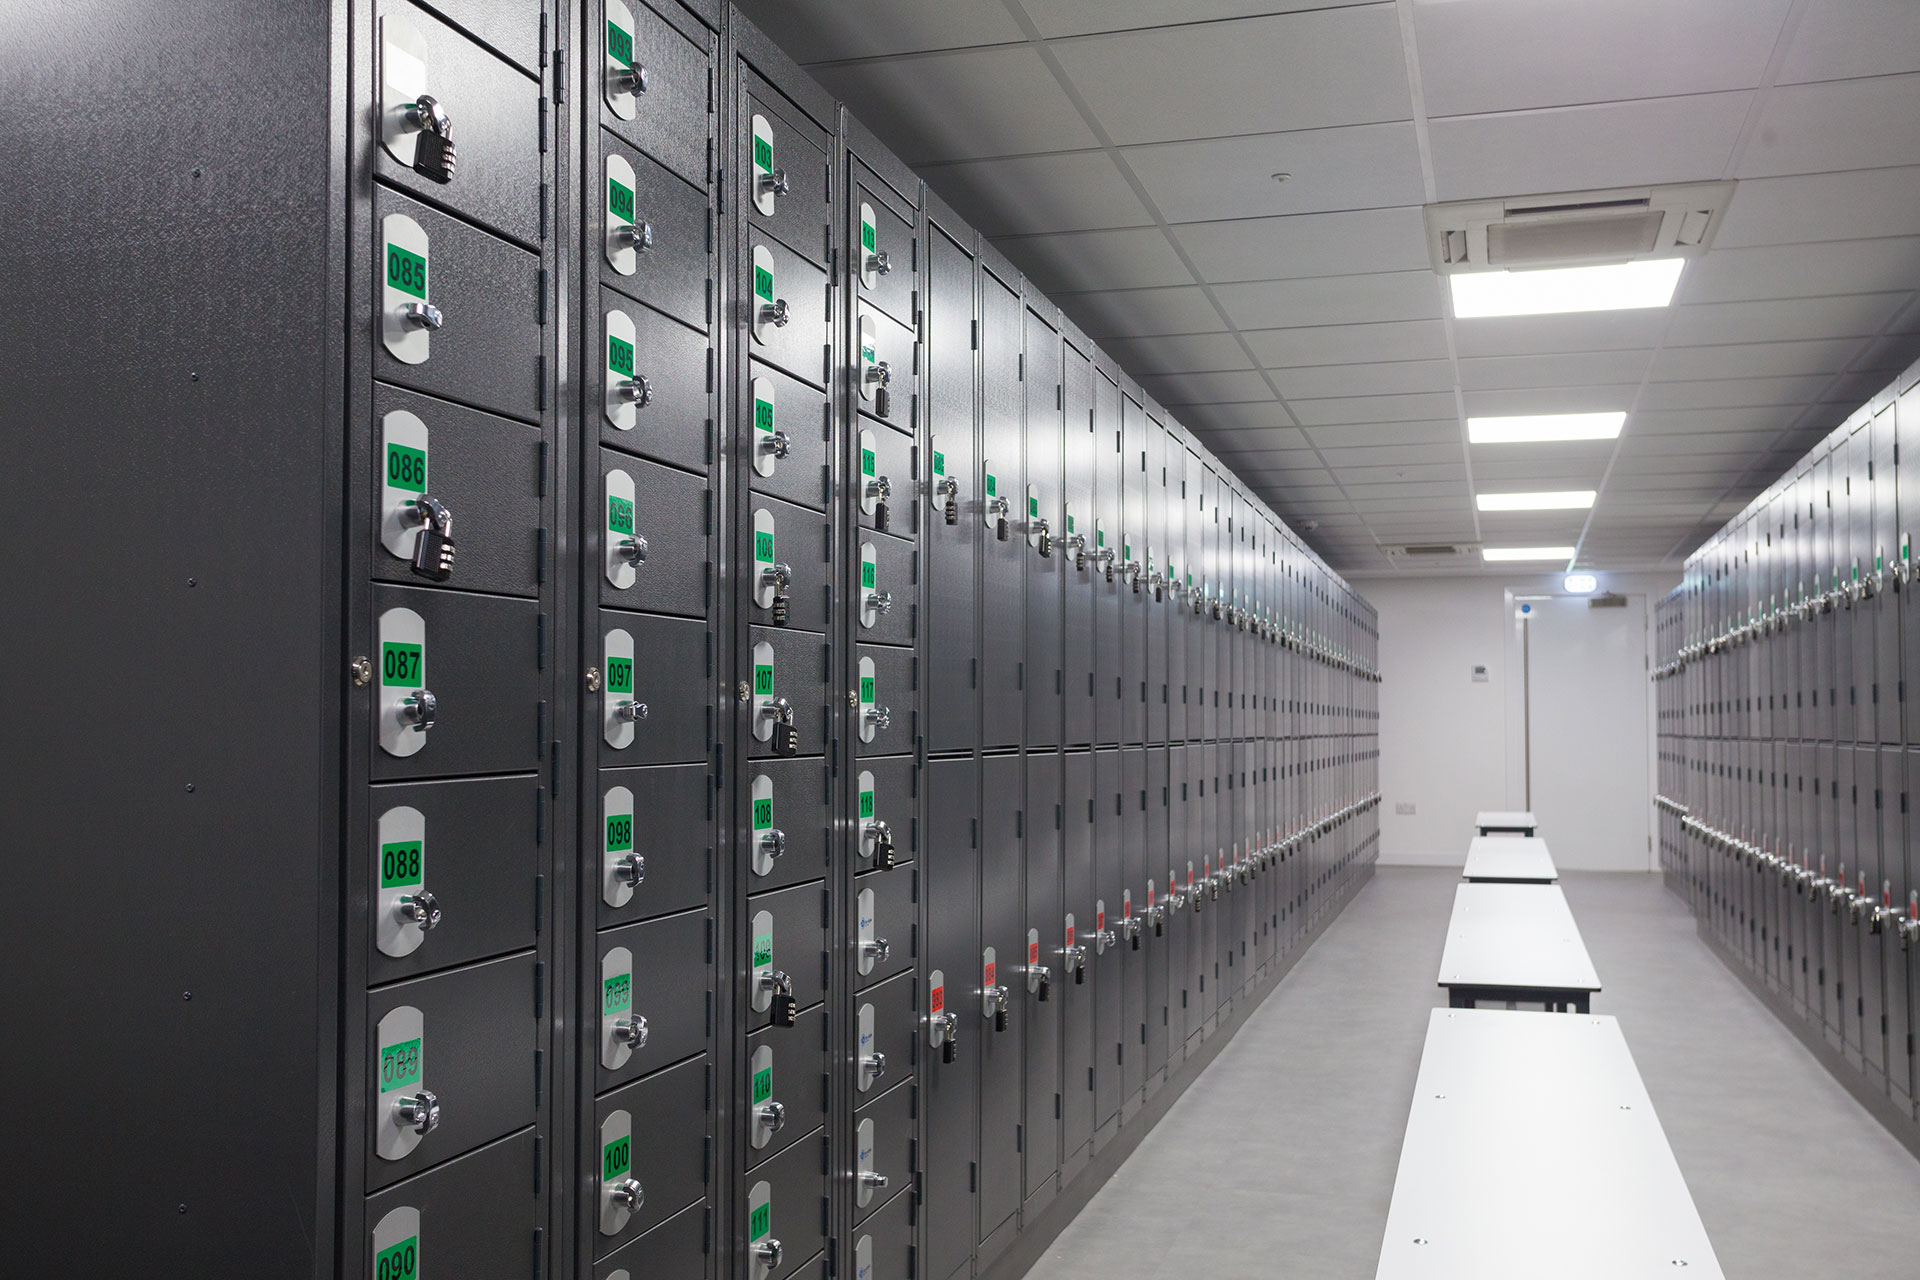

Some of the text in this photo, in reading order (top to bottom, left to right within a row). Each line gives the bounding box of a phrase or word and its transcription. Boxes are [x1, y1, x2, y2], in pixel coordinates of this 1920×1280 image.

[609, 28, 632, 62] 093
[755, 141, 772, 169] 103
[611, 185, 634, 219] 094
[389, 252, 424, 291] 085
[756, 272, 773, 297] 104
[610, 342, 633, 372] 095
[756, 404, 773, 428] 105
[389, 451, 424, 485] 086
[610, 502, 633, 529] 096
[757, 534, 773, 558] 106
[384, 649, 420, 680] 087
[608, 663, 632, 687] 097
[756, 670, 772, 690] 107
[862, 681, 874, 699] 117
[755, 803, 772, 825] 108
[861, 795, 873, 813] 118
[608, 821, 632, 846] 098
[384, 848, 419, 880] 088
[606, 980, 629, 1009] 099
[383, 1047, 418, 1084] 089
[754, 1073, 771, 1098] 110
[605, 1142, 628, 1174] 100
[752, 1207, 768, 1236] 111
[378, 1245, 415, 1280] 090
